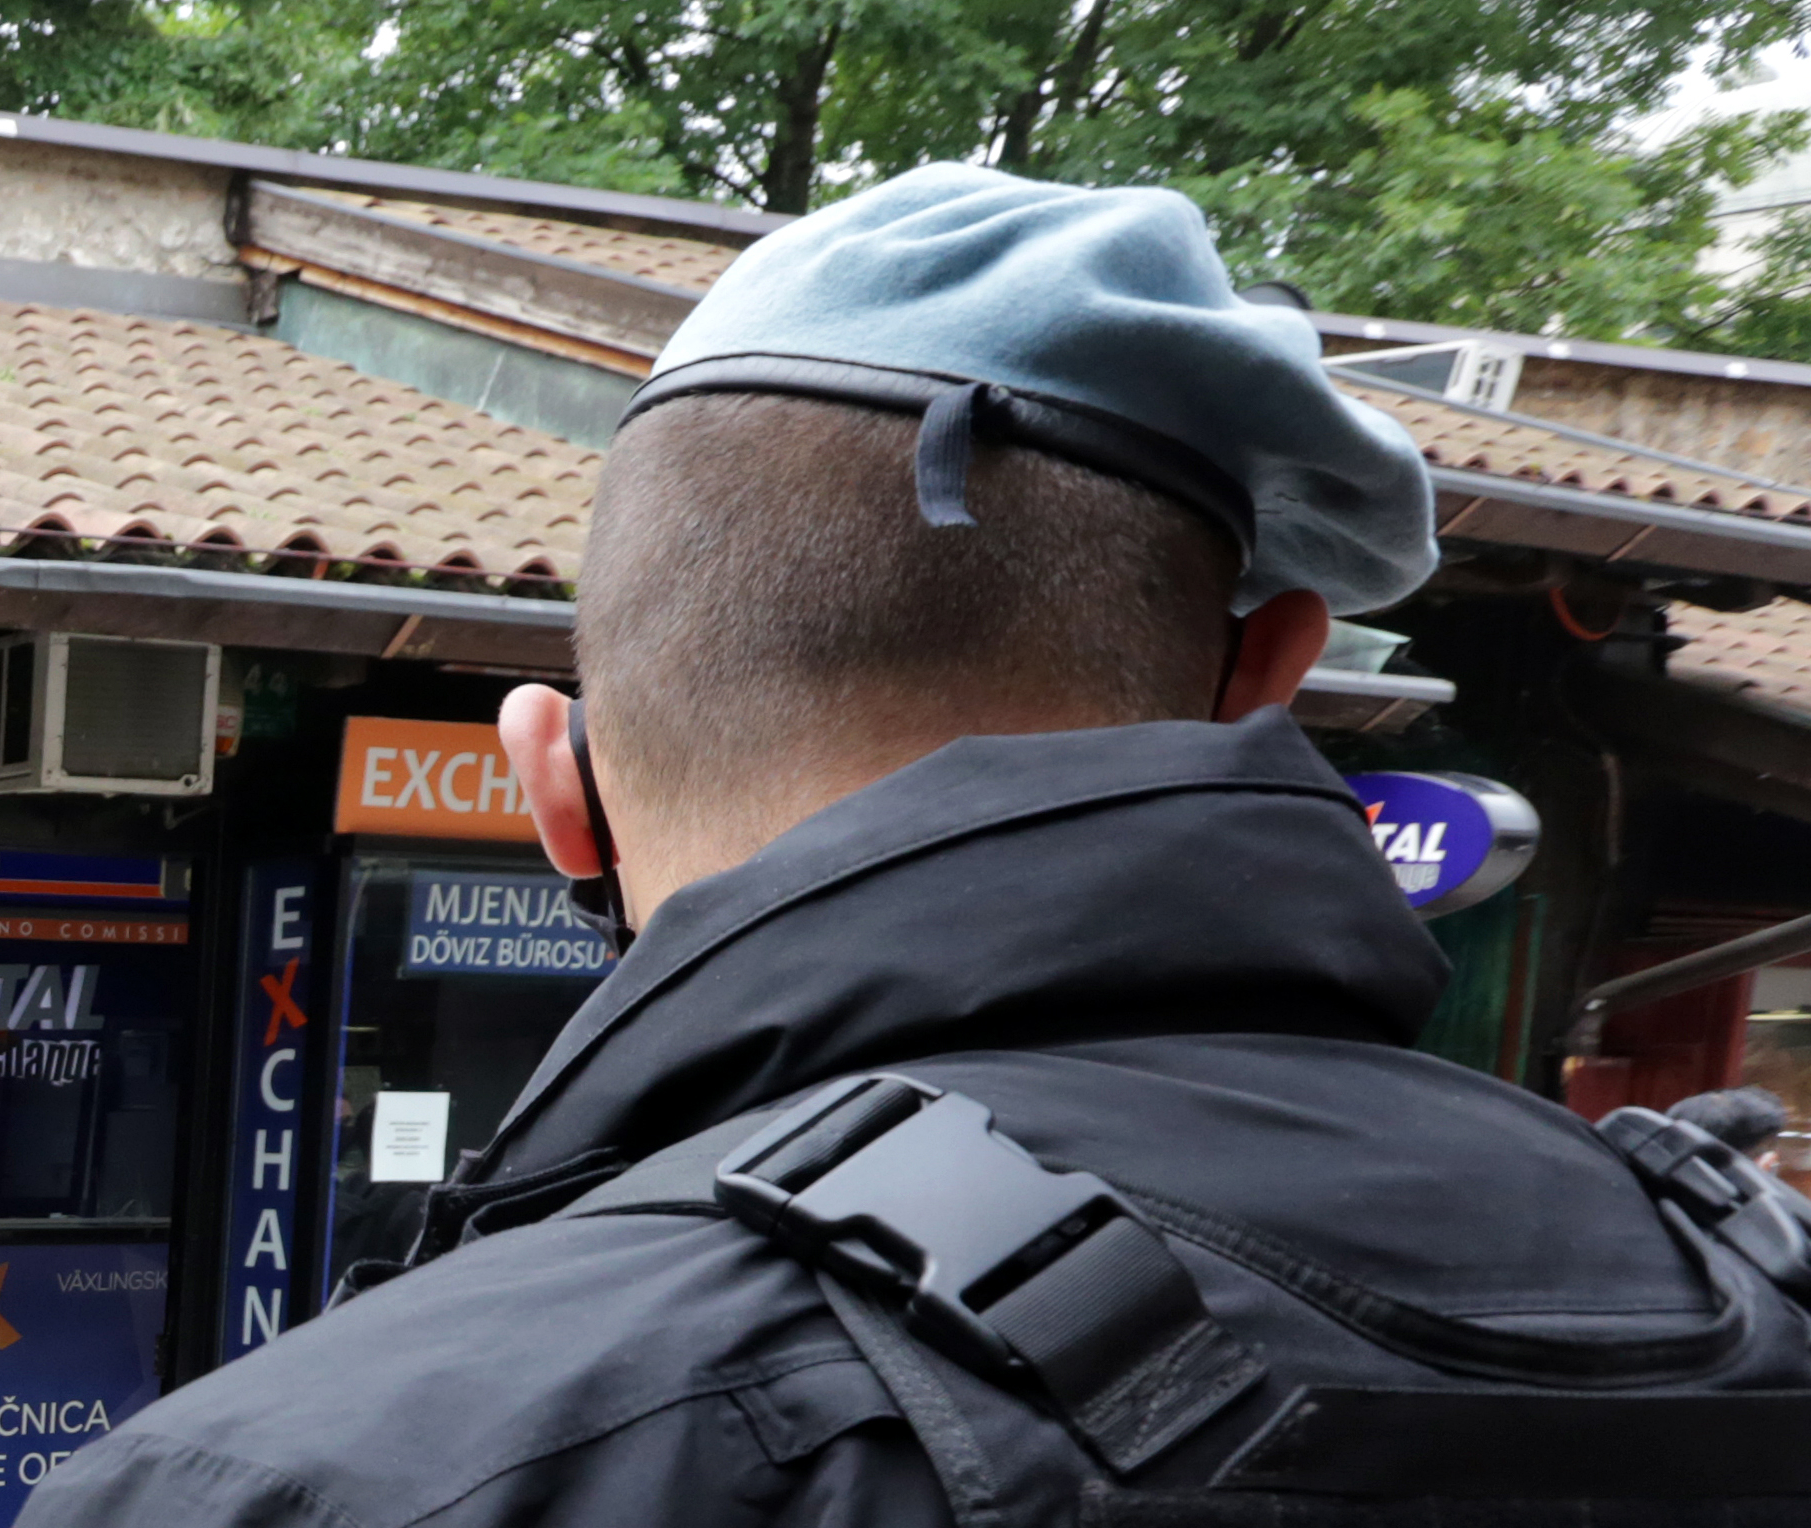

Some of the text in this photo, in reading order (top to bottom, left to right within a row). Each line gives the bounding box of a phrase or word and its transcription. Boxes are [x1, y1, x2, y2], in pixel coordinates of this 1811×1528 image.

[361, 746, 534, 815] EXCH
[59, 923, 179, 941] COMISSI
[241, 885, 309, 1346] EXCHAN
[18, 1450, 81, 1487] OF
